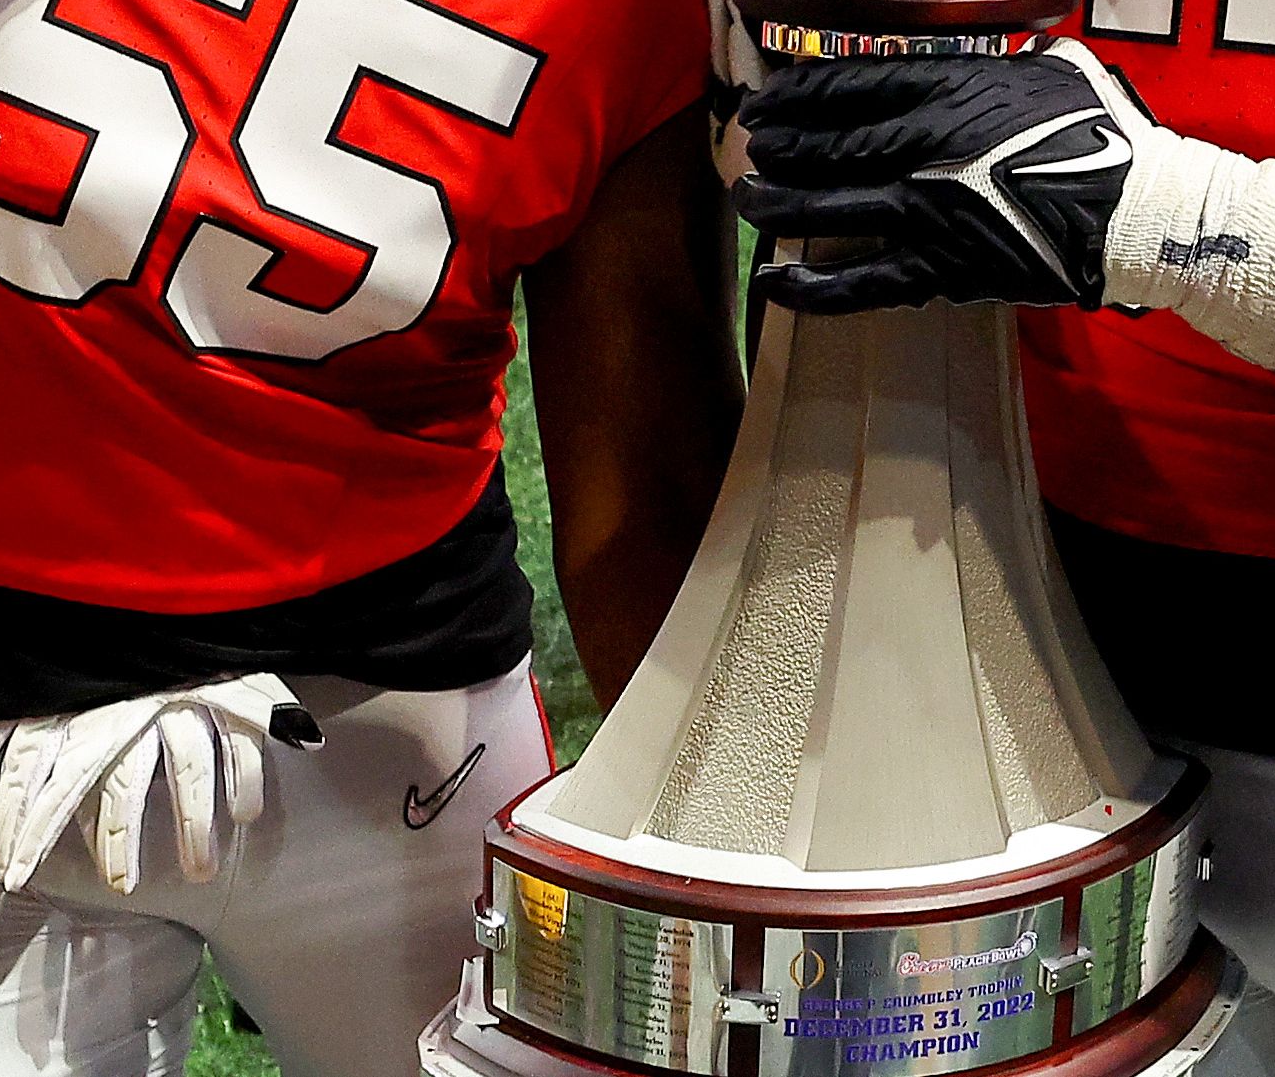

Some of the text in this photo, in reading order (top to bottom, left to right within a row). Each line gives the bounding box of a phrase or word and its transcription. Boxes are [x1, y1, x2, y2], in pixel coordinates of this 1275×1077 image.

[783, 990, 1036, 1038] DECEMBER 31, 2022
[845, 1031, 981, 1064] CHAMPION
